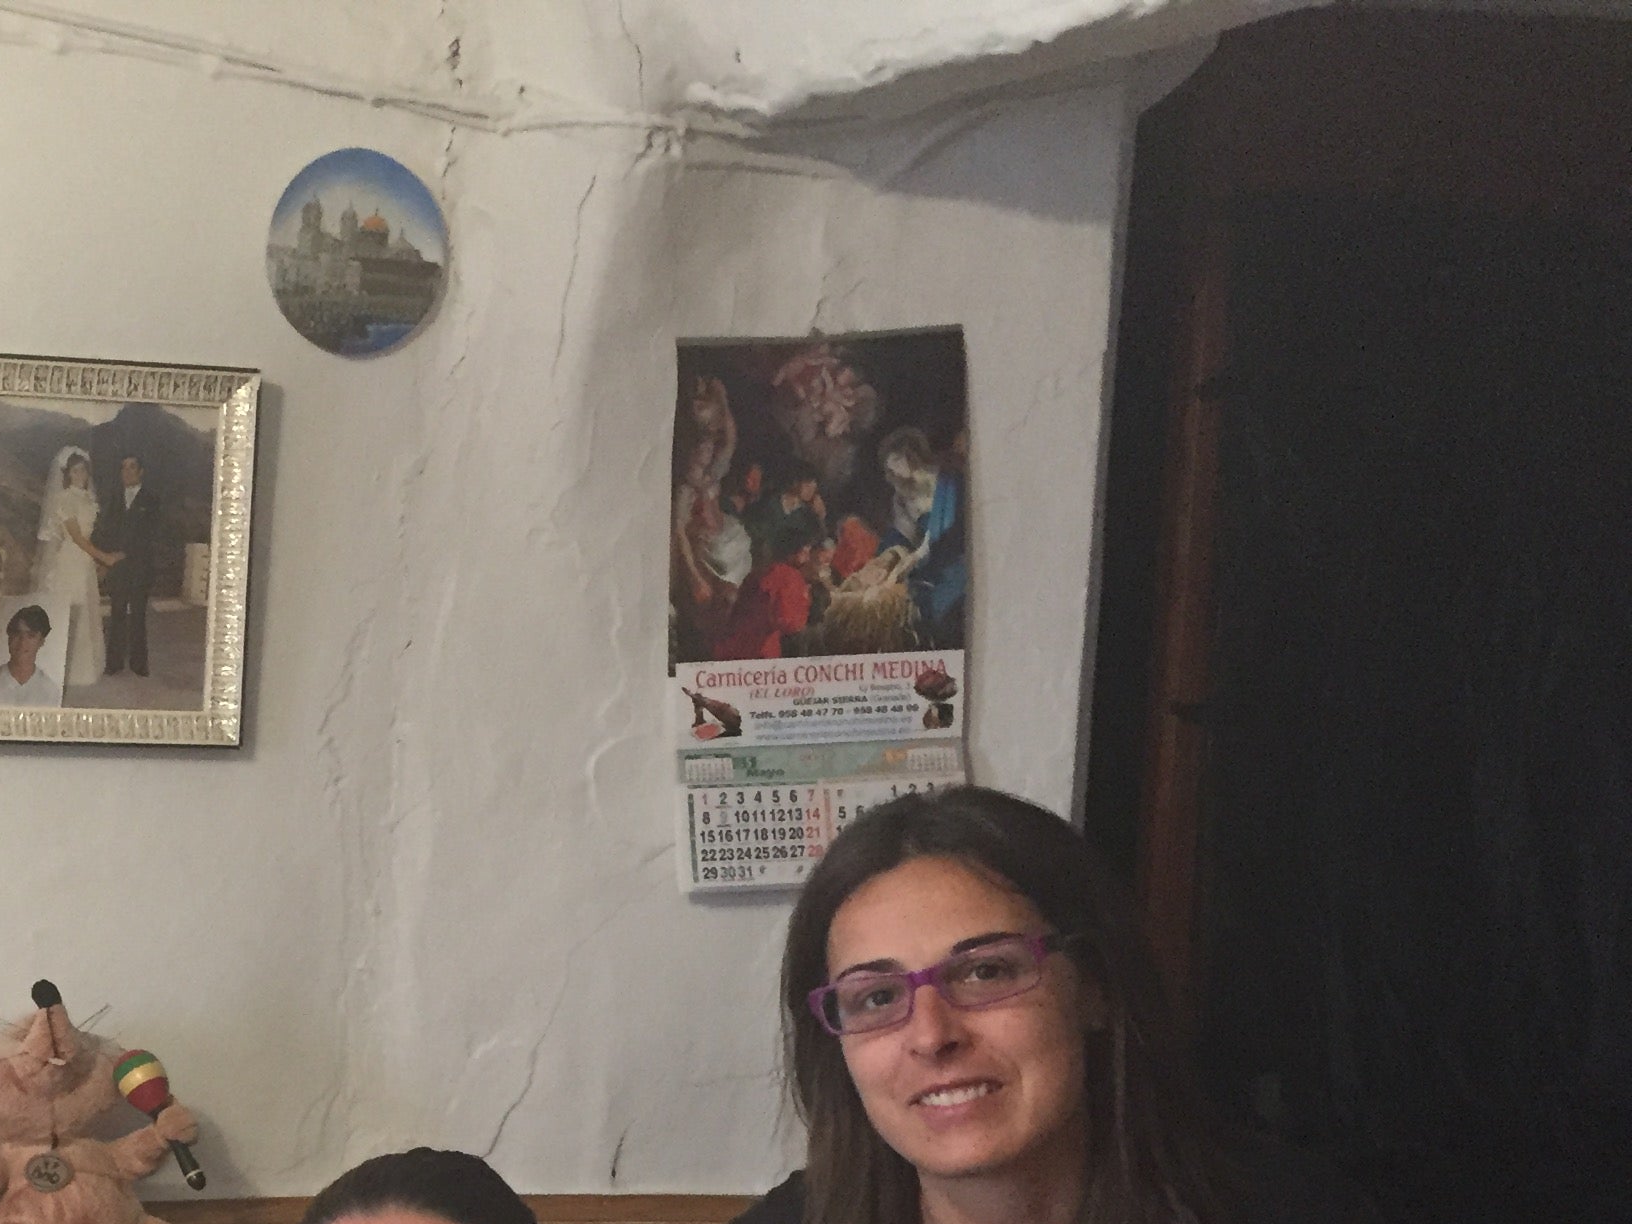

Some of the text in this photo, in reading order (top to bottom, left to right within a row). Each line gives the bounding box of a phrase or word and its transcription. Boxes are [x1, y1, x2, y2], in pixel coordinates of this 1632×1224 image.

[696, 658, 947, 688] Carnicería CONCHI MEDINA
[702, 794, 707, 805] 1
[719, 792, 728, 805] 2
[736, 792, 744, 804] 3
[754, 791, 762, 803] 4
[772, 790, 780, 803] 5
[789, 789, 798, 802] 6
[702, 812, 710, 824] 8
[735, 810, 750, 823] 10
[752, 810, 766, 823] 11
[770, 809, 786, 822] 12
[787, 808, 802, 821] 13
[806, 808, 820, 820] 14
[838, 806, 846, 819] 5
[700, 827, 820, 843] 15 16 17 18 19 20 21
[701, 849, 717, 862] 22
[719, 848, 734, 861] 23
[736, 848, 752, 860] 24
[754, 847, 770, 859] 25
[772, 846, 788, 858] 26
[790, 846, 805, 857] 27
[702, 866, 752, 879] 29 30 31
